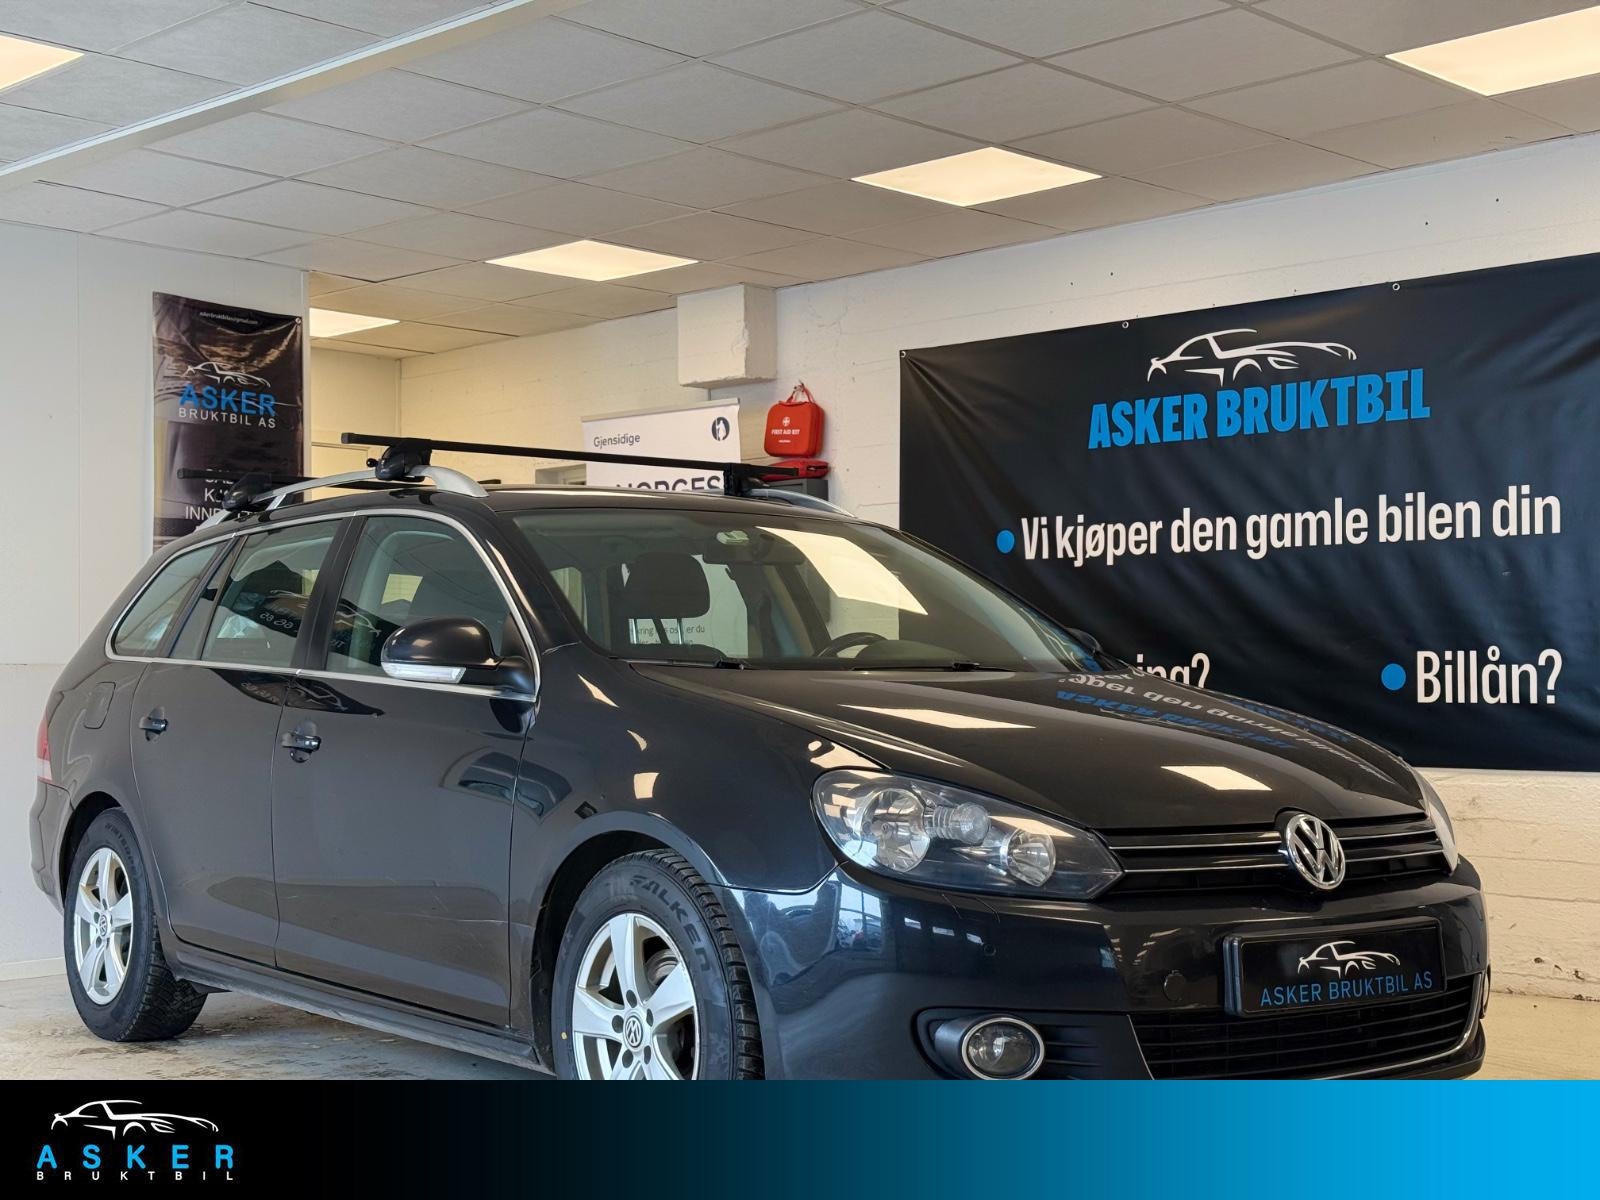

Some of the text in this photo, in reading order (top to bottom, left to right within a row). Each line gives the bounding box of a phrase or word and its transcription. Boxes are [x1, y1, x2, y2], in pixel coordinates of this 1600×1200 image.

[178, 383, 277, 417] ASKER
[178, 407, 276, 429] BRUKTBIL AS
[1088, 368, 1431, 450] ASKER BRUKTBIL
[593, 433, 640, 449] Gjensidige
[1021, 484, 1561, 568] Vi kjøper den gamle bilen din
[1416, 645, 1563, 704] Billån?
[1260, 970, 1433, 1007] ASKER BRUKTBIL AS
